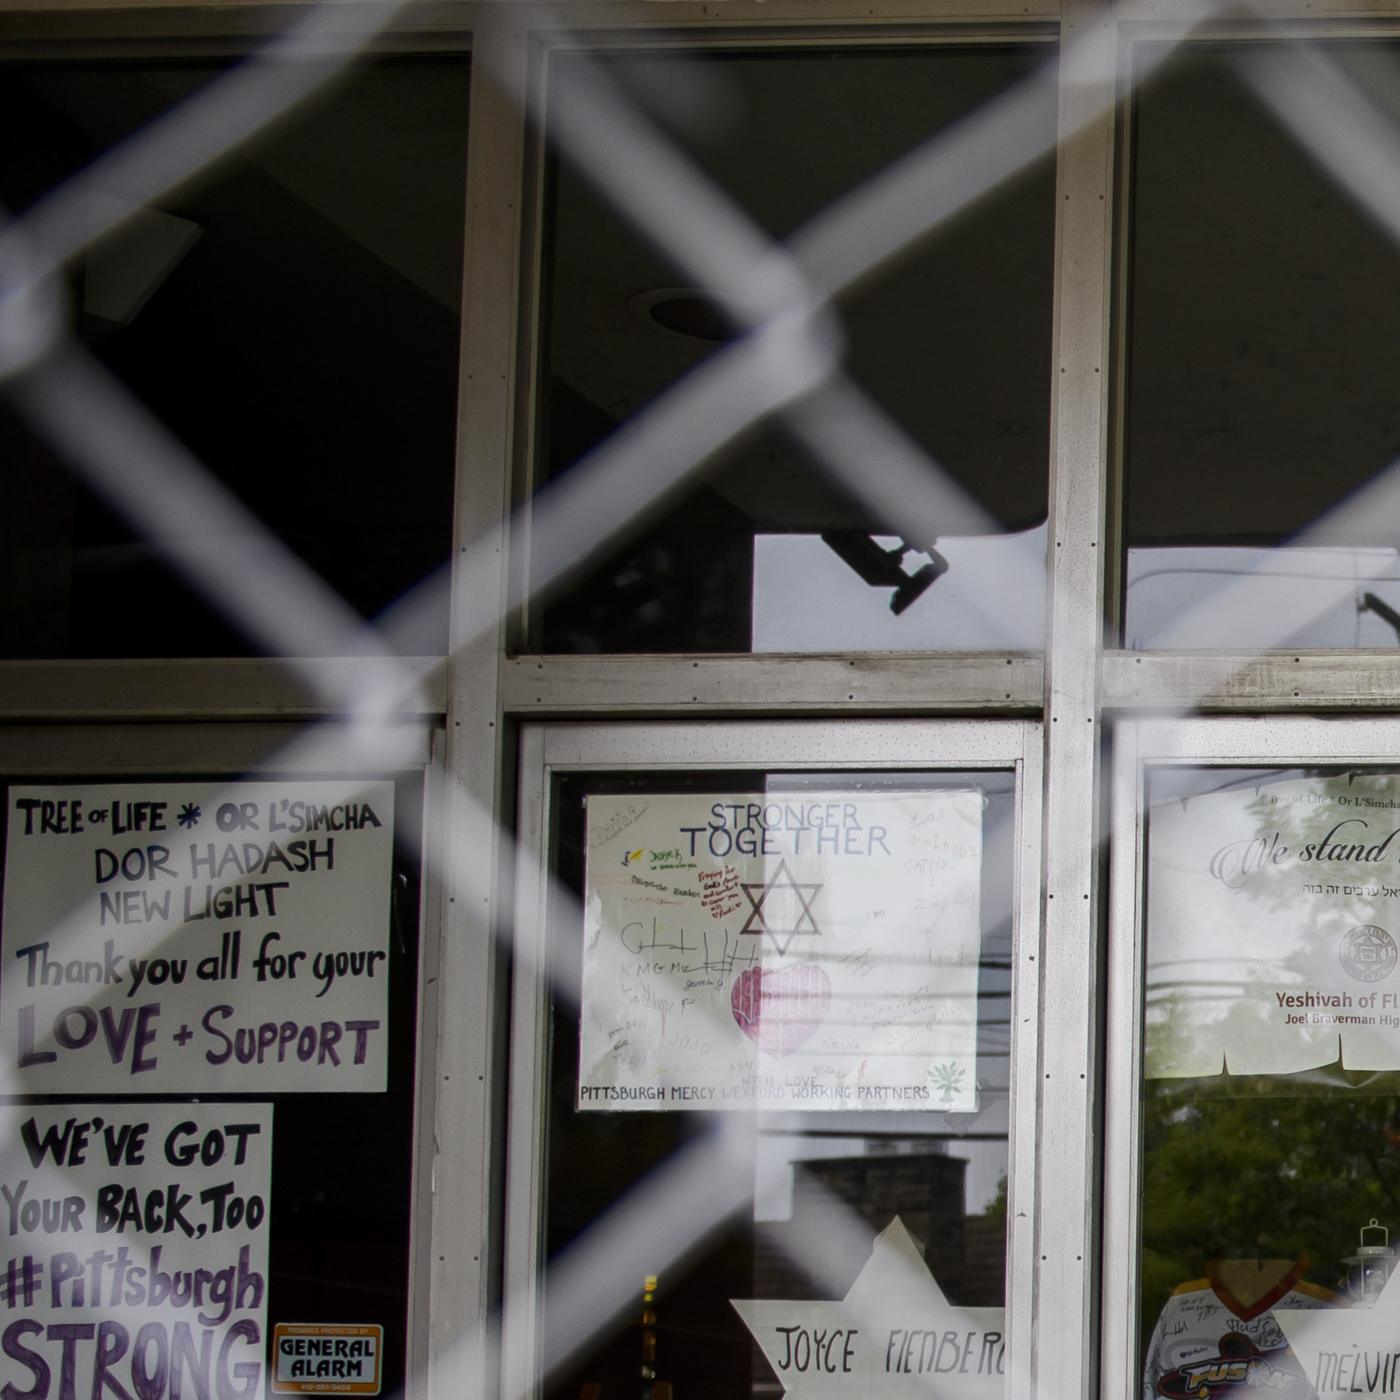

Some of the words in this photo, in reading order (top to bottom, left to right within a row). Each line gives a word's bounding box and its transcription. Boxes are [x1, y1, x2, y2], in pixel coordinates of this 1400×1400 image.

[1293, 794, 1304, 804] of
[1306, 794, 1328, 805] Life
[1338, 796, 1352, 805] Or
[17, 799, 84, 835] TREE
[112, 801, 167, 834] LIFE
[217, 802, 259, 832] OR
[269, 801, 382, 831] L'SIMCHA
[708, 803, 861, 830] STRONGER
[680, 826, 892, 856] TOGETHER
[95, 848, 179, 883] DOR
[189, 838, 334, 877] HADASH
[1210, 833, 1290, 888] We
[100, 890, 172, 924] NEW
[183, 883, 290, 922] LIGHT
[1302, 884, 1323, 895] בזה
[1326, 884, 1340, 895] זה
[1344, 885, 1379, 896] ערבים
[16, 940, 124, 989] Thank
[126, 958, 187, 997] you
[196, 932, 241, 981] all
[253, 932, 306, 982] for
[313, 949, 386, 996] your
[1276, 992, 1352, 1009] Yeshivah
[1358, 993, 1377, 1008] of
[1285, 1013, 1308, 1025] Joel
[1312, 1013, 1375, 1025] Braverman
[17, 1002, 162, 1075] LOVE
[581, 1086, 665, 1101] PITTSBURGH
[671, 1086, 715, 1100] MERCY
[722, 1086, 785, 1100] WEXFORD
[789, 1086, 854, 1100] WORKING
[858, 1086, 929, 1100] PARTNERS
[21, 1117, 149, 1168] WE'VE
[164, 1123, 261, 1166] GOT
[1, 1245, 265, 1325] #Pittsburgh
[281, 1339, 374, 1358] GENERAL
[775, 1326, 858, 1373] JOYCE
[291, 1360, 362, 1378] ALARM
